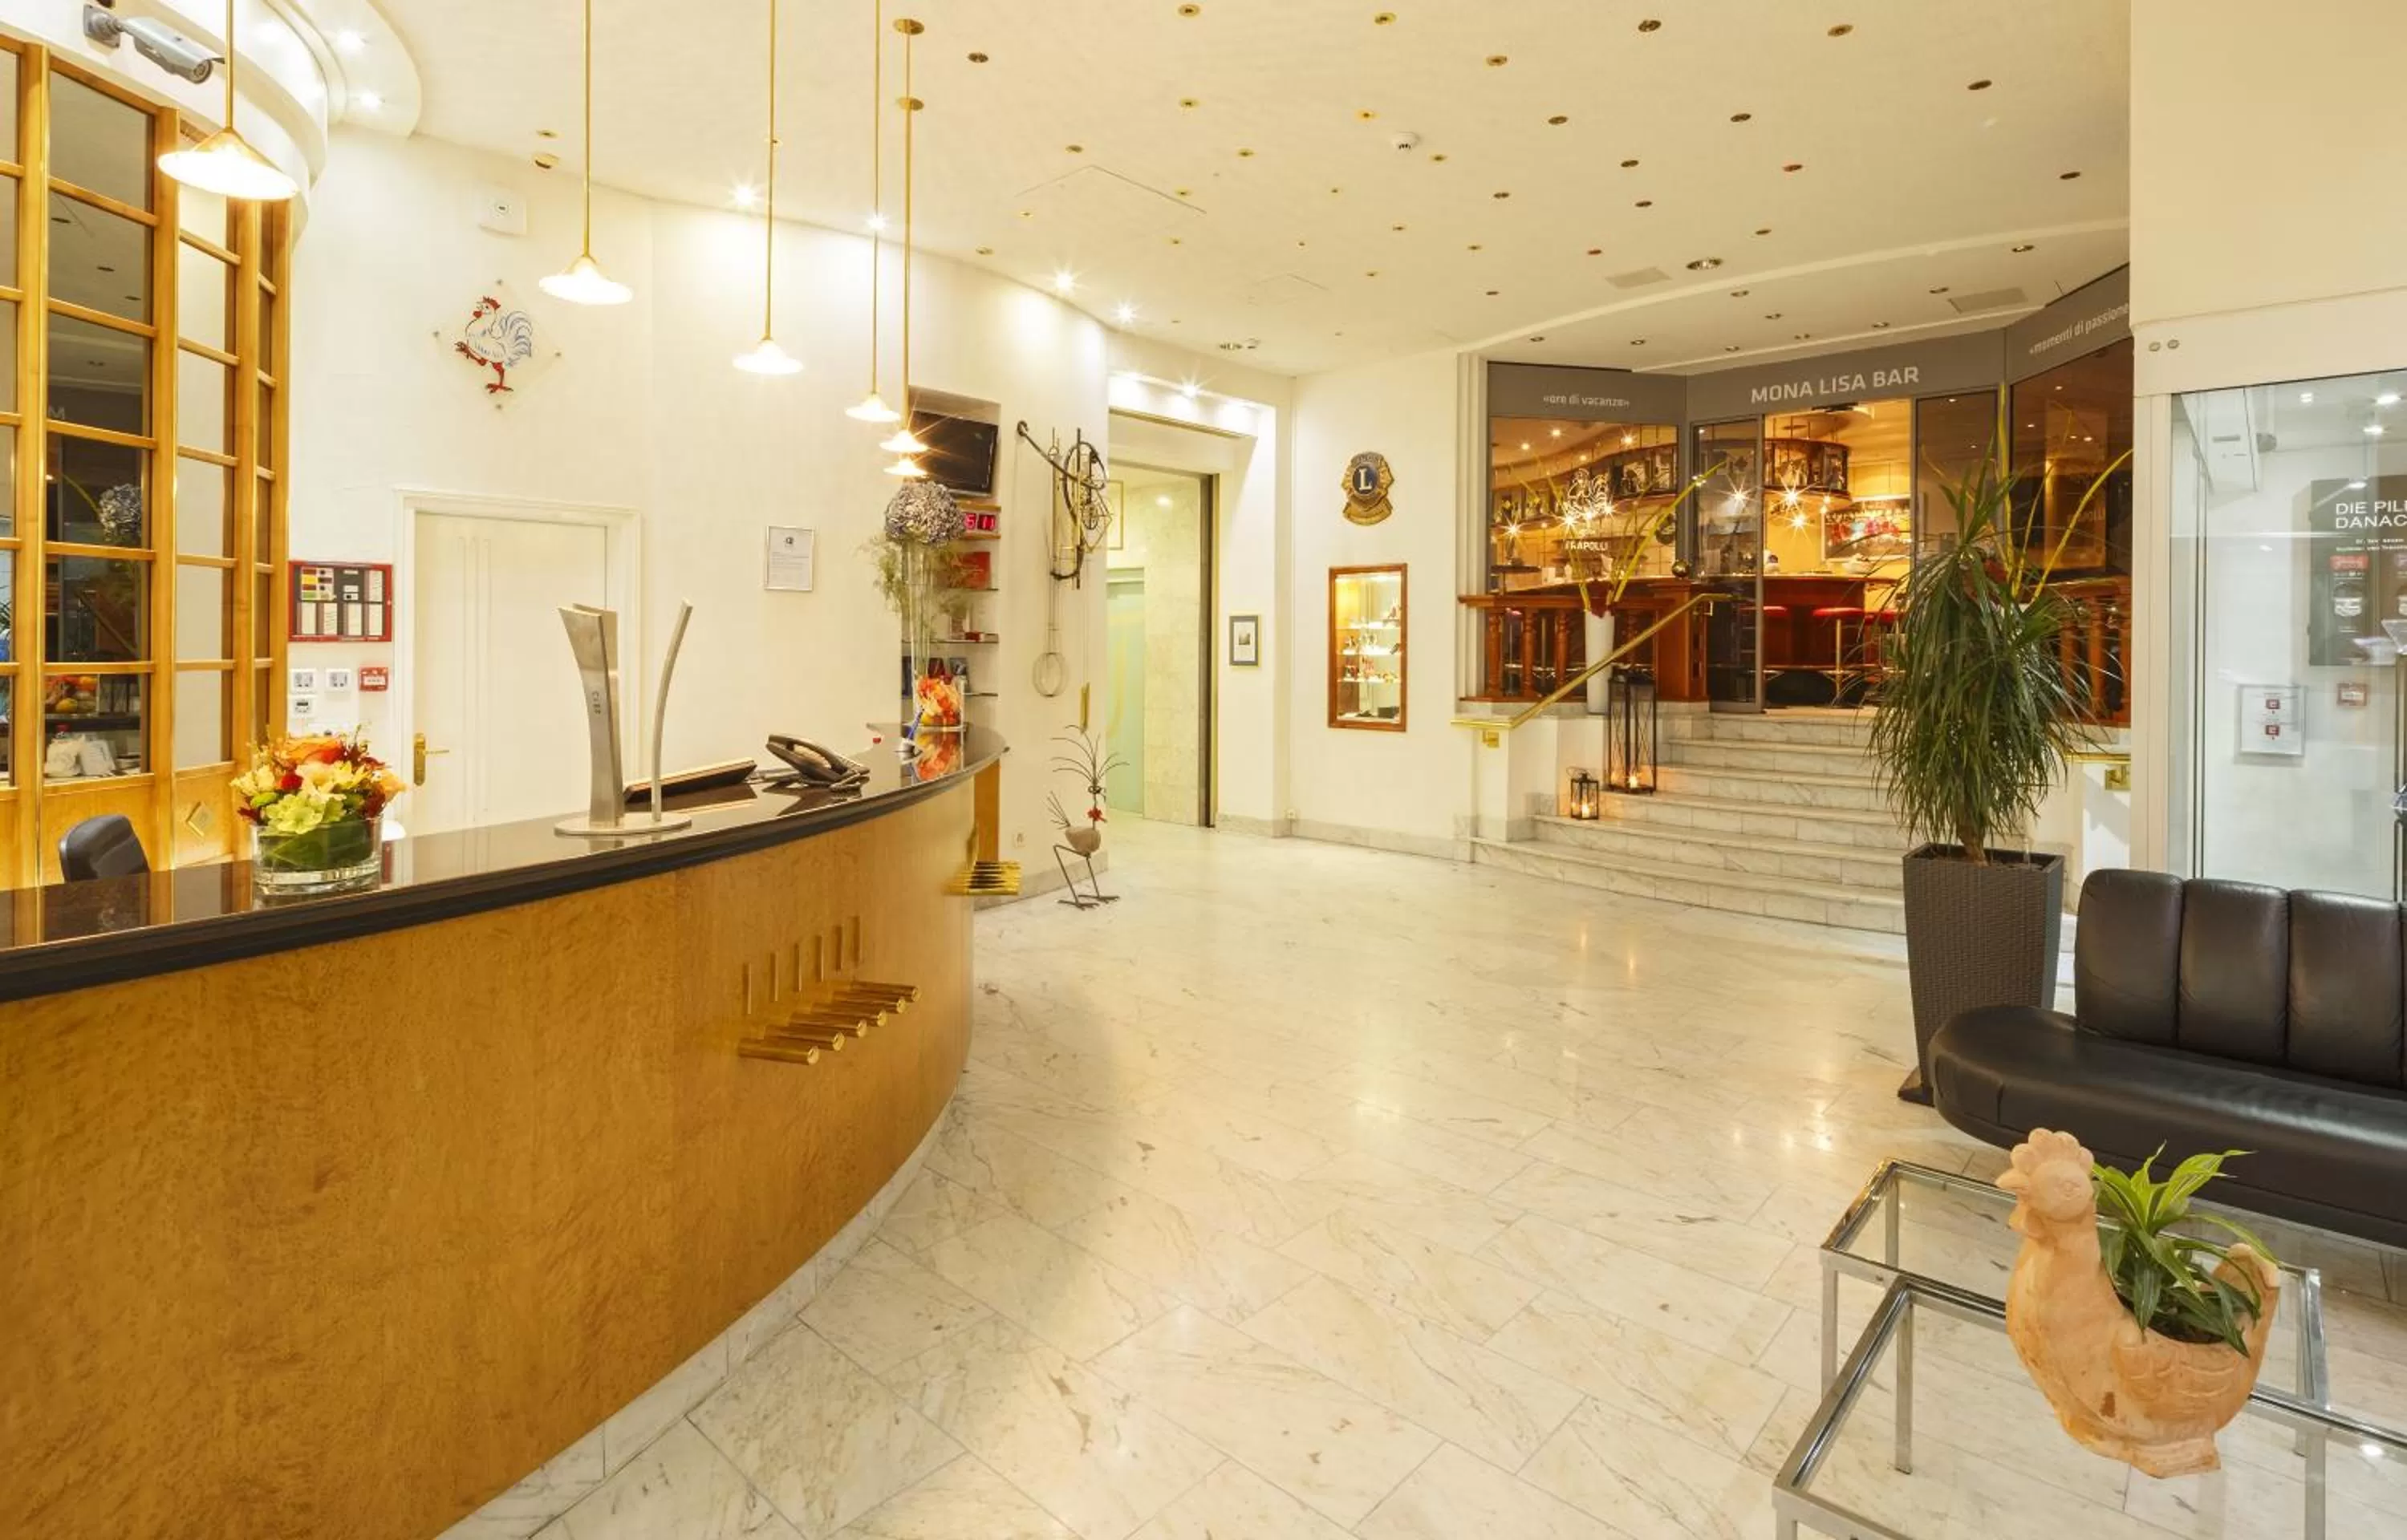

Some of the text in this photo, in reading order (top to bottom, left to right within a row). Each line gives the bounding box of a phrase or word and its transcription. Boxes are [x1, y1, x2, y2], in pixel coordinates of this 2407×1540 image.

[2074, 320, 2084, 336] di
[1751, 366, 1920, 404] MONA LISA BAR
[1569, 393, 1580, 405] di
[1358, 468, 1373, 490] L
[2336, 501, 2368, 515] DIE
[2336, 514, 2407, 529] DANAC
